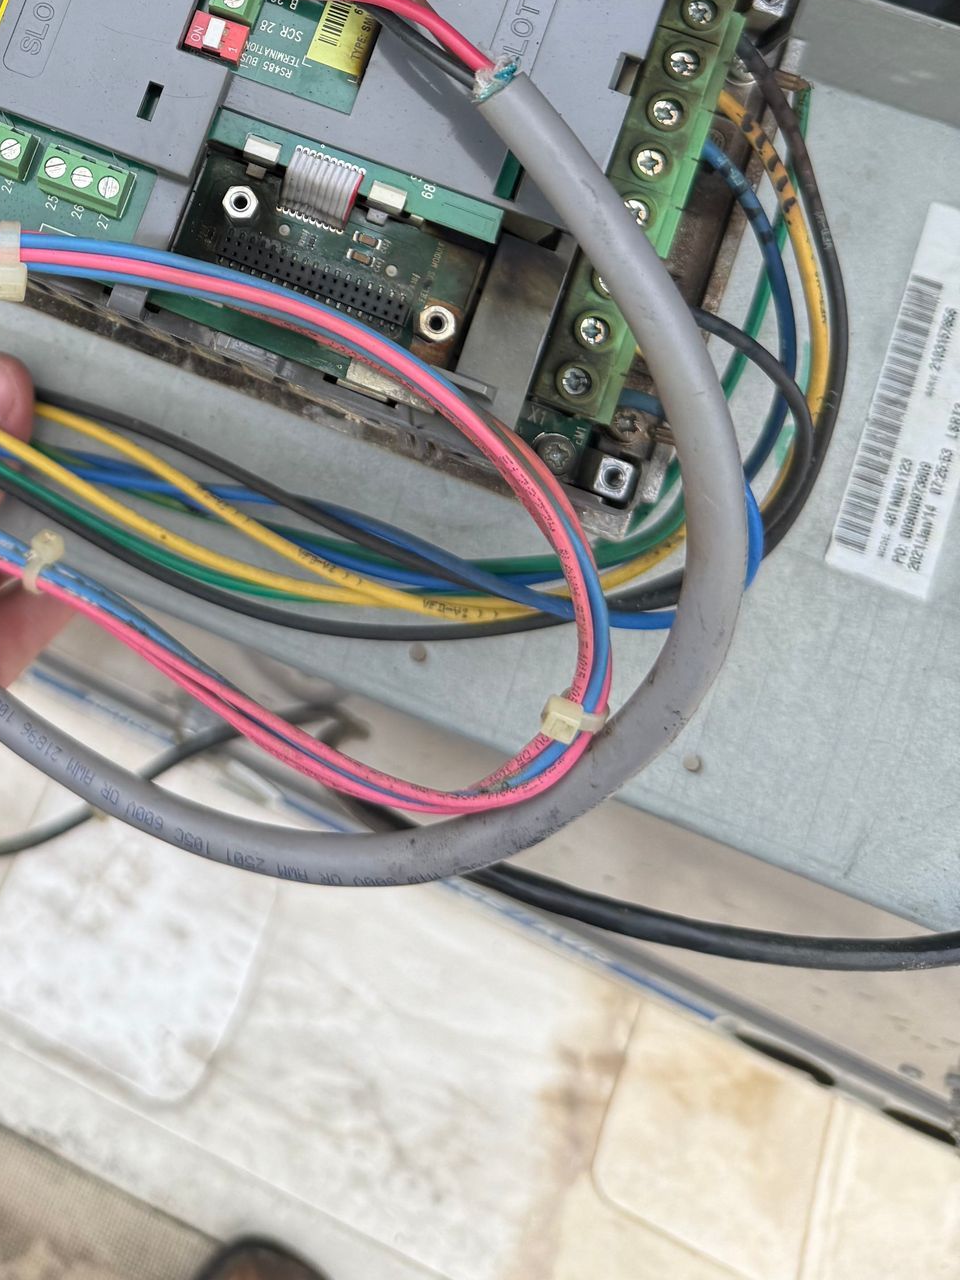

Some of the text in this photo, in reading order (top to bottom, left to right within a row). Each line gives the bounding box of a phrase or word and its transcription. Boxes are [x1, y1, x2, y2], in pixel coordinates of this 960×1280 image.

[190, 25, 204, 42] ON
[259, 19, 304, 43] SCR 28
[240, 52, 293, 79] RS485 BUS
[244, 41, 301, 68] TERMINATION
[1, 179, 15, 194] 24
[45, 195, 59, 211] 25
[71, 204, 85, 220] 26
[96, 214, 110, 230] 27
[66, 758, 96, 785] AWM
[100, 780, 121, 806] OR
[125, 803, 164, 831] 600V
[173, 827, 211, 855] 105C
